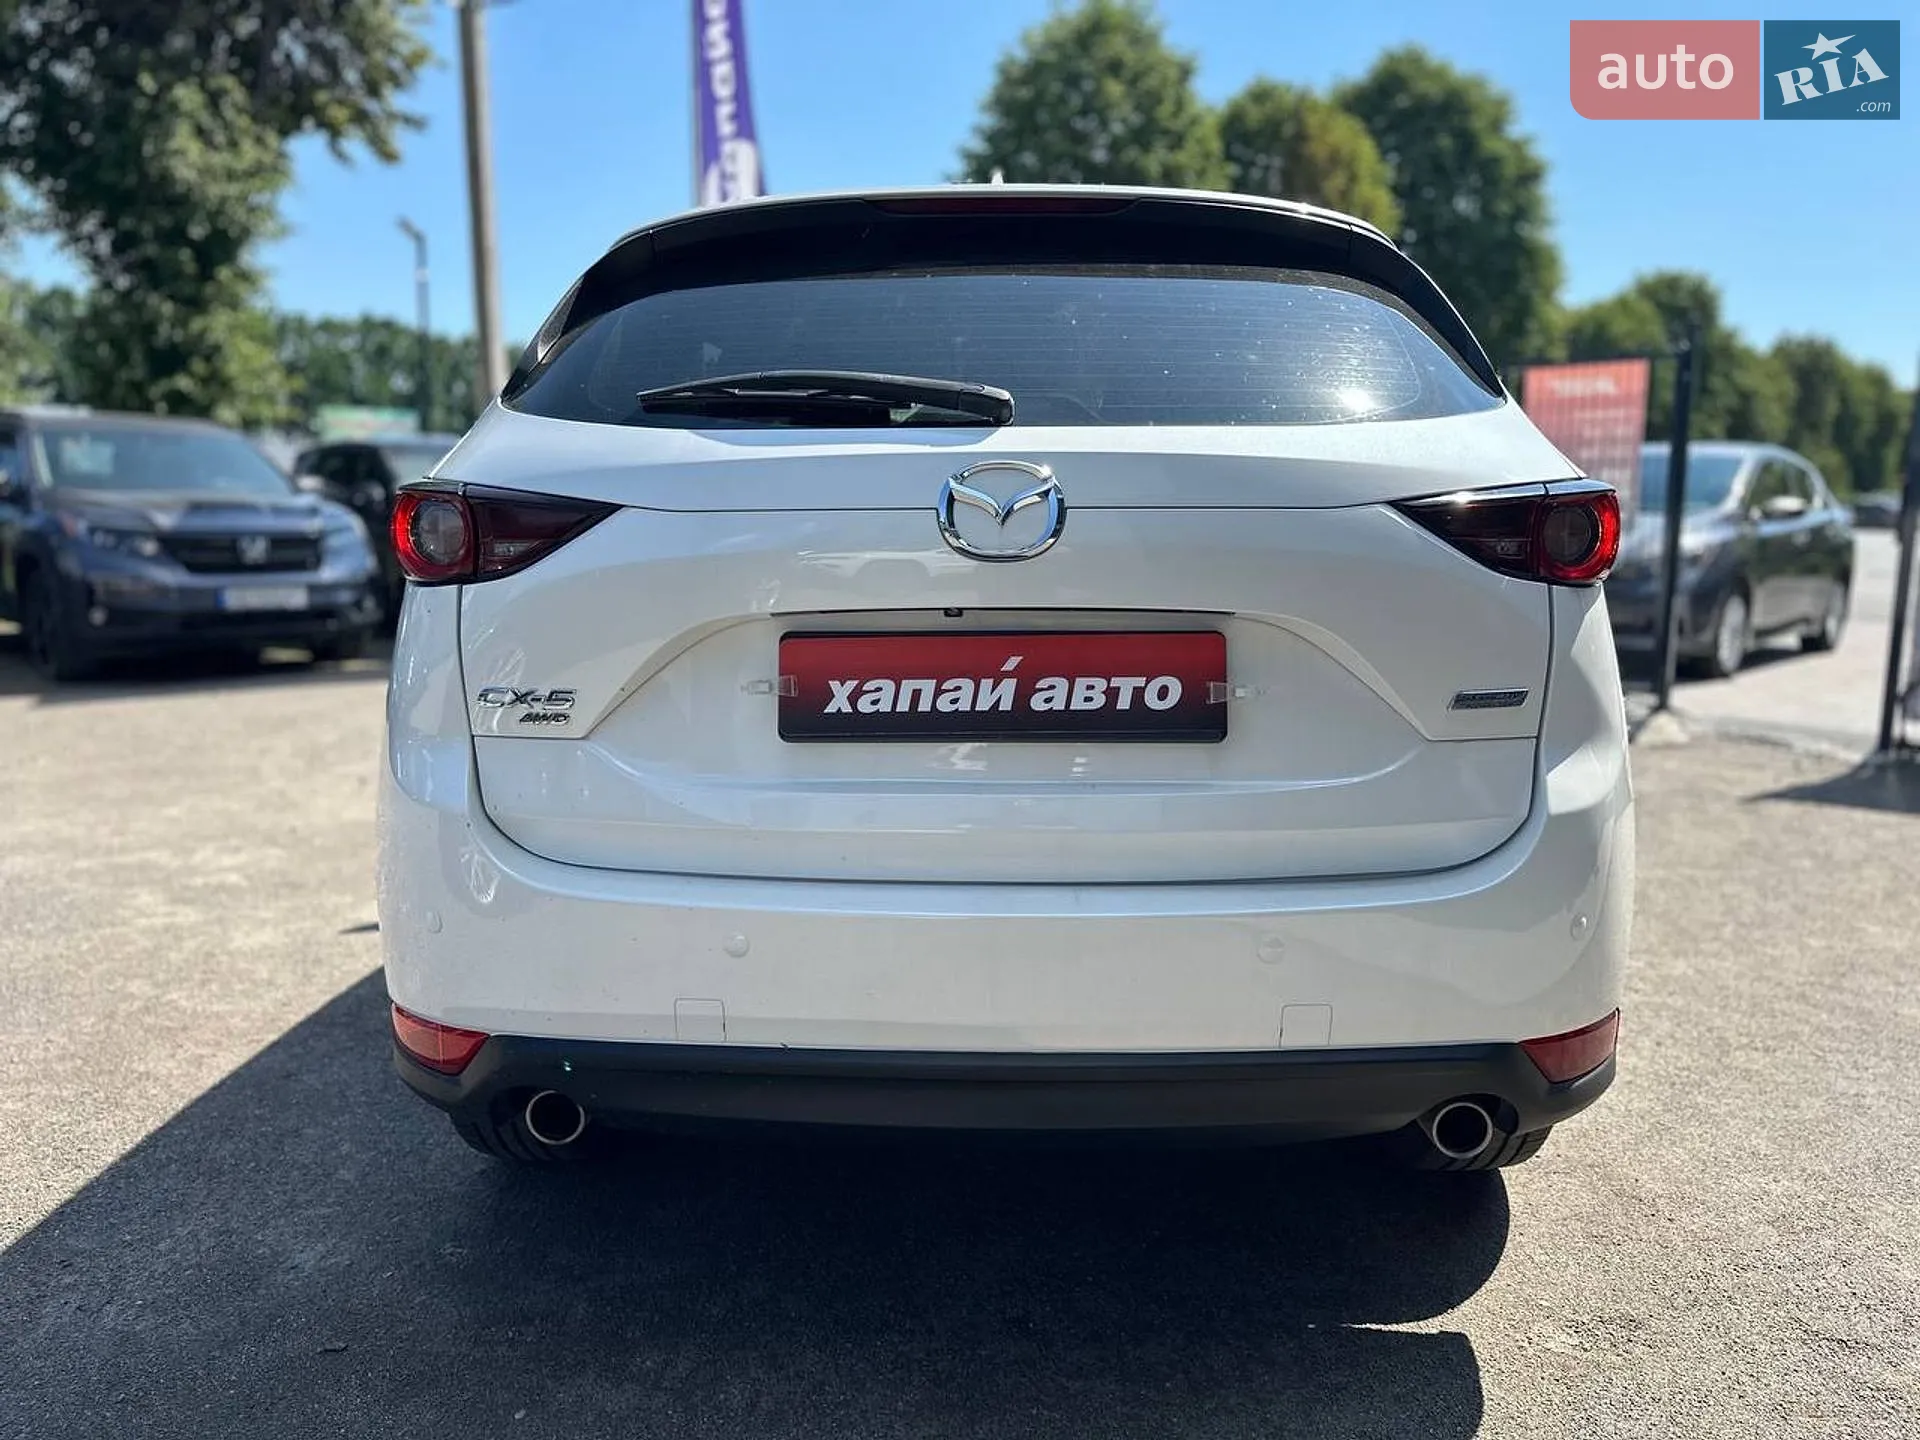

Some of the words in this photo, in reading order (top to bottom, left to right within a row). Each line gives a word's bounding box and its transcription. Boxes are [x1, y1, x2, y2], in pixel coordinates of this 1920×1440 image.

[477, 687, 577, 711] CX-5
[1030, 676, 1182, 711] авто
[519, 711, 570, 725] AWD
